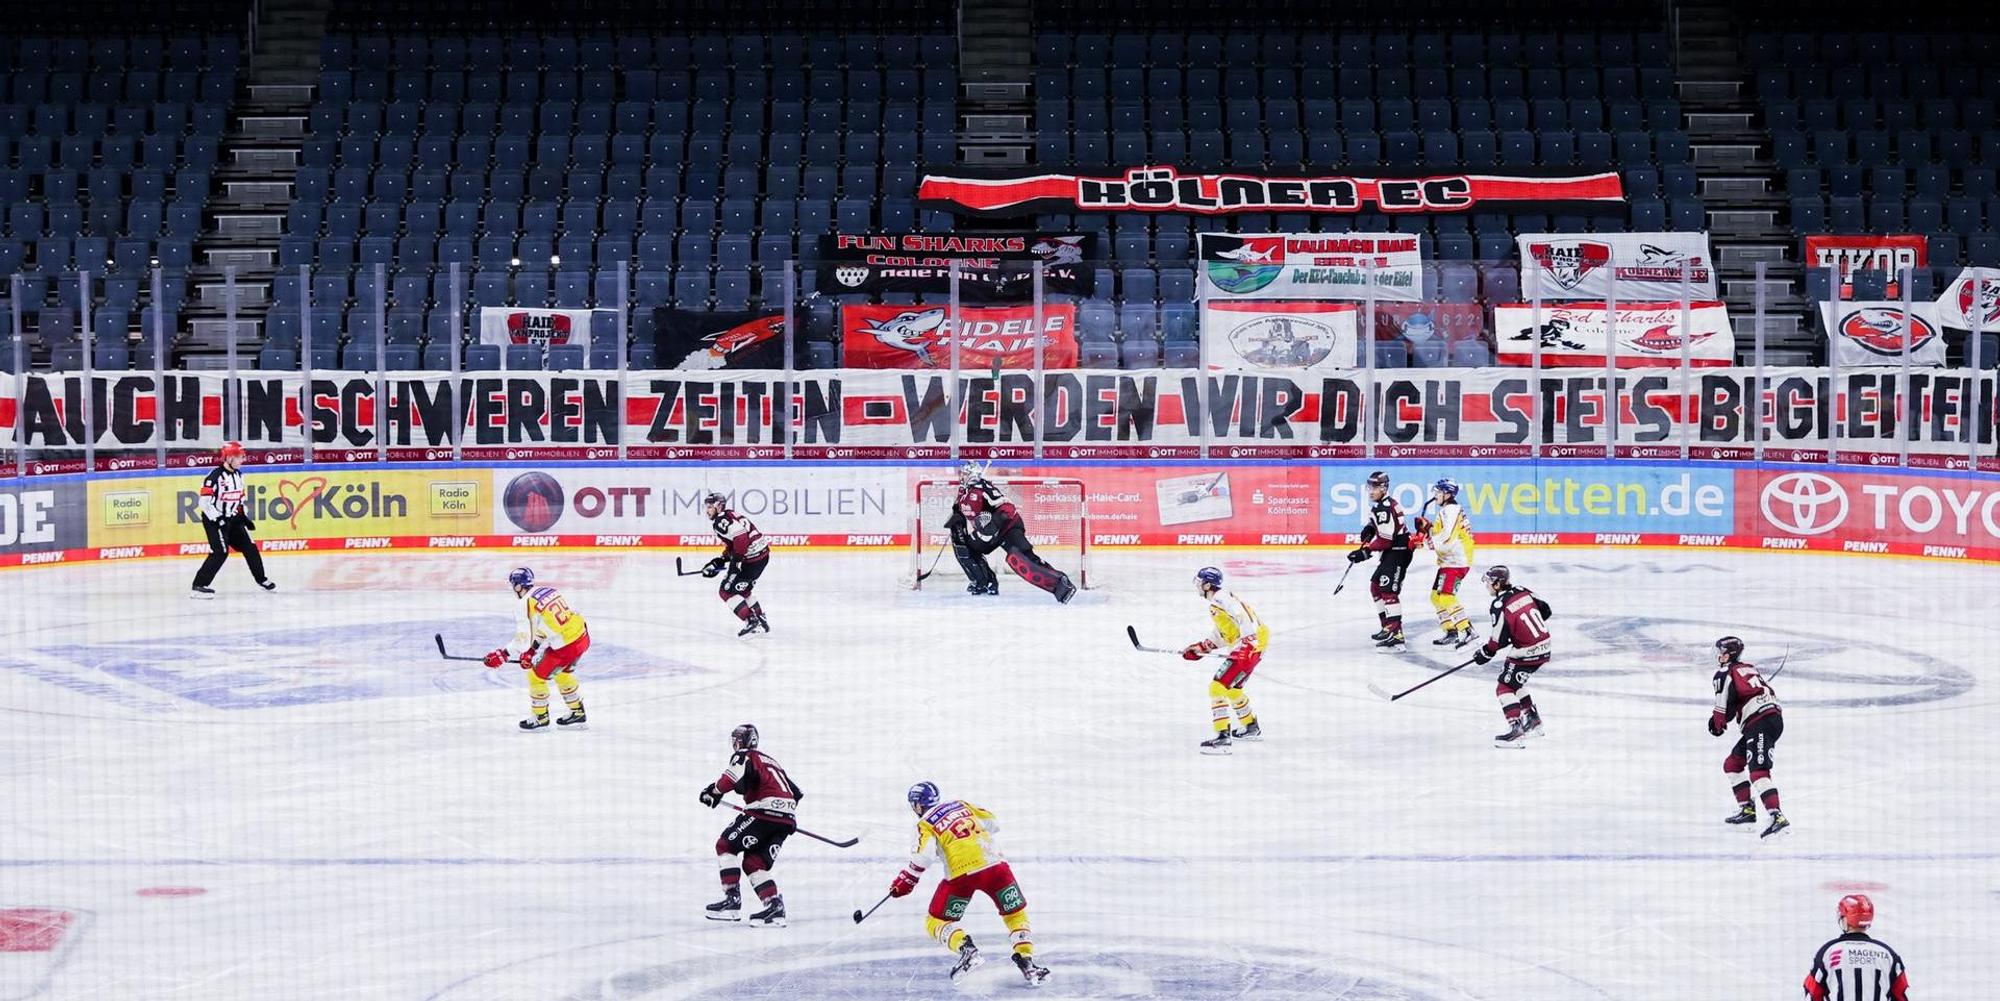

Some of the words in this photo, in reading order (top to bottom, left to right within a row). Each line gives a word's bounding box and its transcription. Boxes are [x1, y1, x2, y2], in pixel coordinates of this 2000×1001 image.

[1078, 169, 1359, 207] KÖLNER
[1379, 178, 1472, 207] EC
[837, 235, 896, 250] FUN
[902, 235, 1025, 252] SHARKS
[1292, 269, 1308, 284] Der
[1361, 273, 1378, 286] as
[12, 376, 200, 445] AUCH
[223, 378, 283, 443] IN
[300, 377, 619, 446] SCHWEREN
[647, 379, 842, 444] ZEITEN
[901, 373, 1157, 443] WERDEN
[1181, 374, 1303, 440] WIR
[1319, 377, 1461, 444] DICH
[1491, 376, 1672, 443] STETS
[356, 452, 372, 460] OTT
[694, 449, 740, 457] IMMOBILIEN
[854, 449, 900, 457] IMMOBILIEN
[1417, 448, 1463, 456] IMMOBILIEN
[1802, 452, 1818, 460] OTT
[119, 460, 136, 468] OTT
[197, 456, 213, 464] OTT
[1880, 455, 1896, 463] OTT
[44, 464, 60, 472] OTT
[439, 488, 469, 499] Radio
[1330, 473, 1724, 525] sowetten.de
[113, 498, 142, 509] Radio
[176, 486, 295, 524] Rdio
[314, 481, 407, 518] Köln
[442, 499, 467, 510] Köln
[573, 486, 651, 518] OTT
[662, 489, 886, 516] IMMOBILIEN
[1267, 496, 1310, 506] Sparkasse
[116, 510, 139, 521] Köln
[1848, 949, 1890, 960] MAGENTA
[1848, 957, 1877, 965] SPORT
